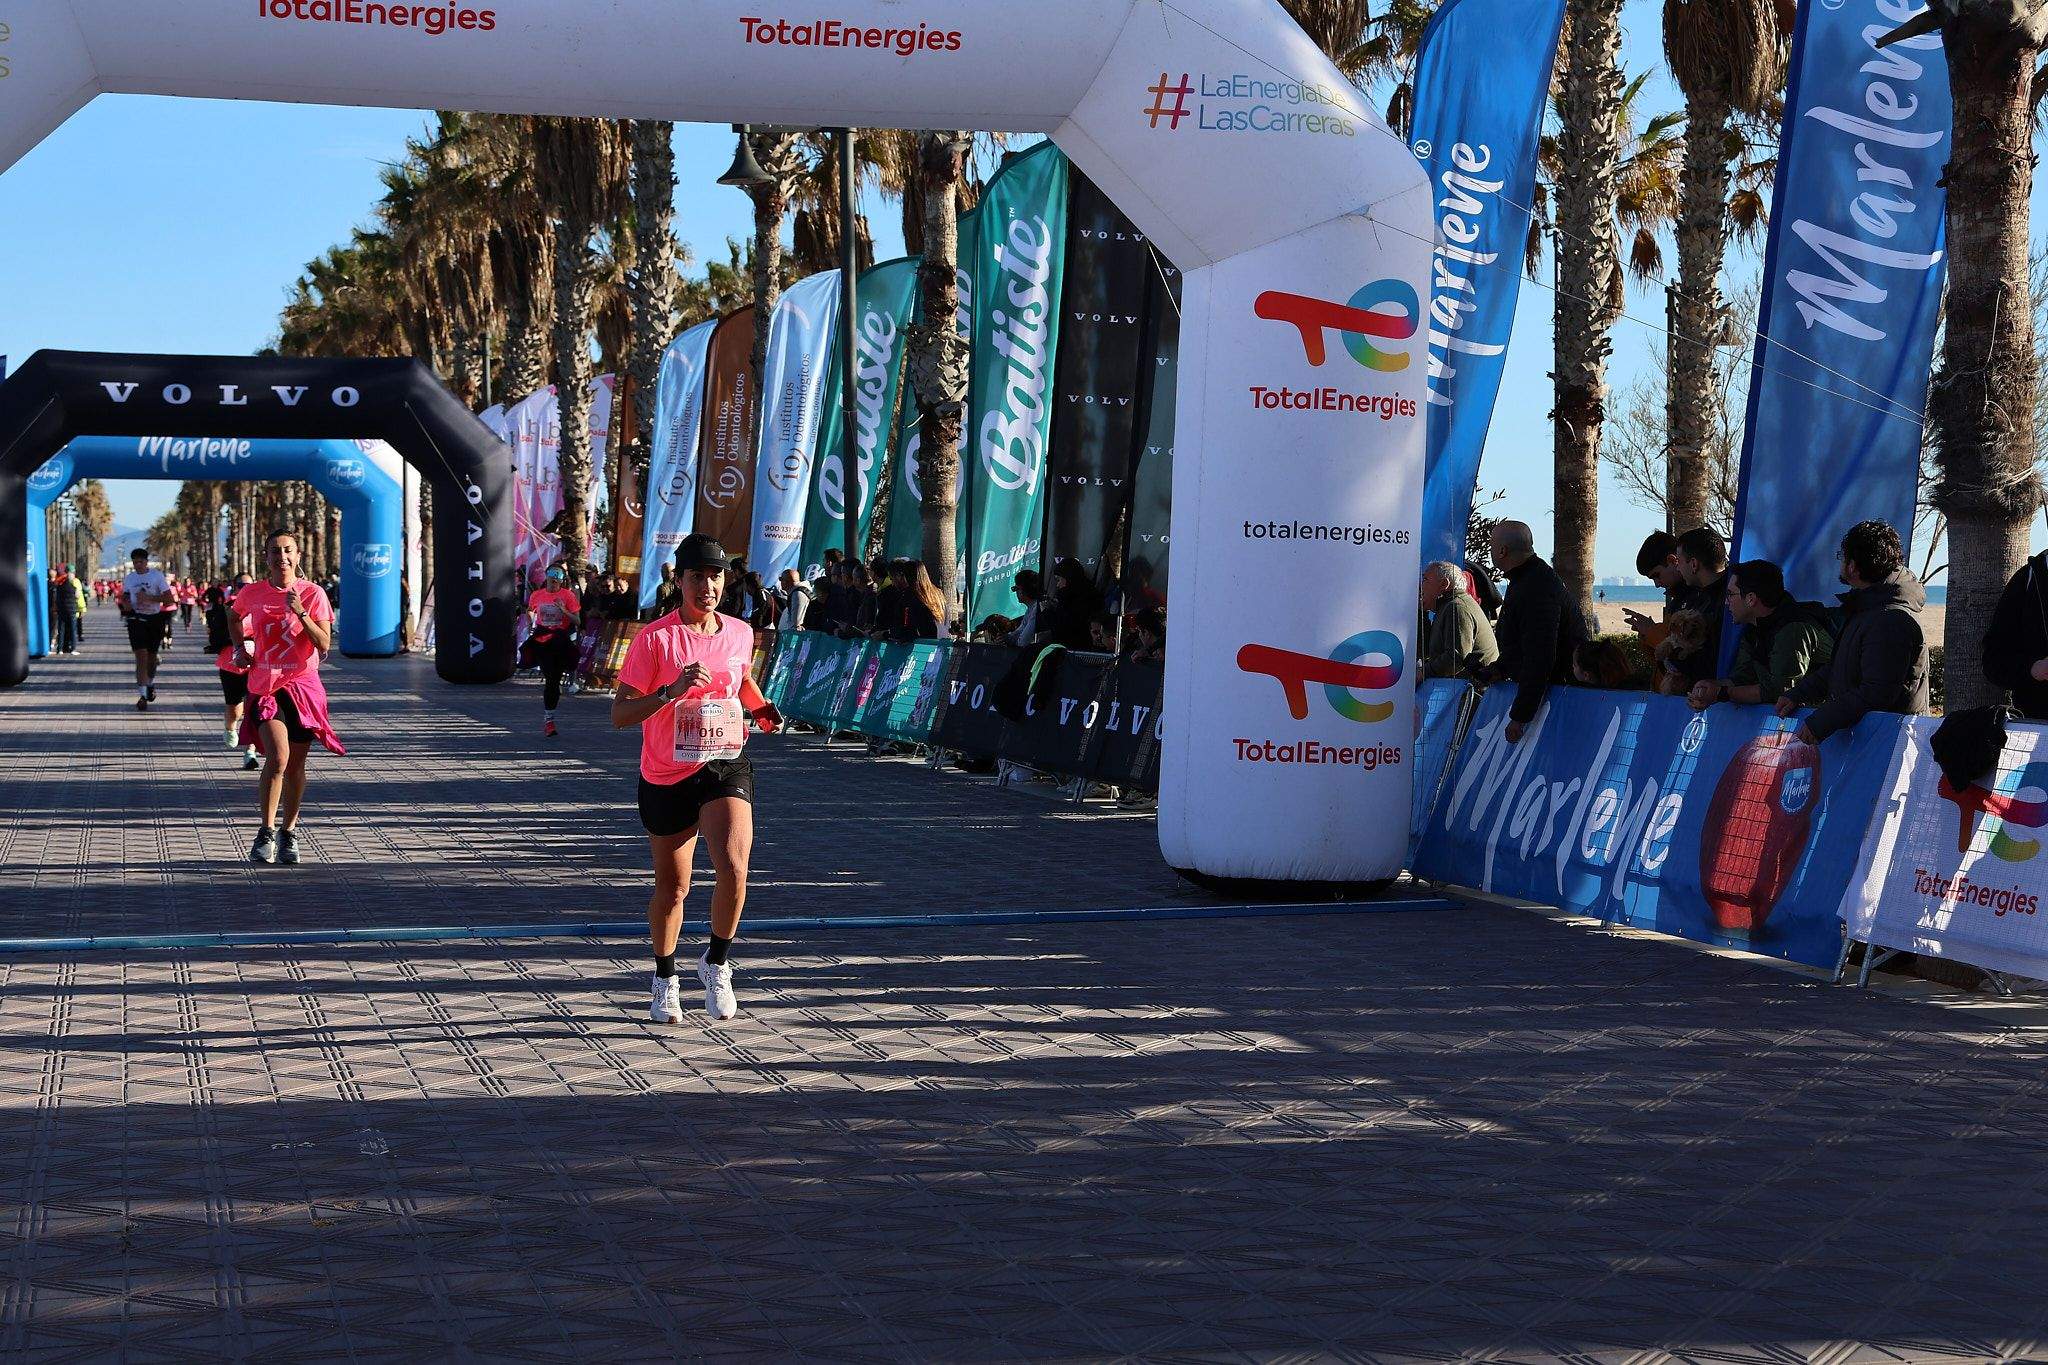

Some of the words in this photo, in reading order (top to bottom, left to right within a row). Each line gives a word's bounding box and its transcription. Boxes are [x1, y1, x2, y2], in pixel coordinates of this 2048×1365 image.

[739, 17, 962, 57] TotalEnergies
[1080, 229, 1145, 242] VOLV
[1074, 312, 1137, 324] VOLV
[980, 214, 1051, 496] Batiste
[100, 381, 360, 407] VOLVO
[1067, 394, 1129, 406] VOLV
[1250, 386, 1416, 420] TotalEnergies
[714, 401, 729, 460] Institutos
[138, 436, 251, 473] Marlene
[1061, 476, 1123, 487] VOLV
[1243, 520, 1410, 545] totalenergies.es
[465, 484, 485, 658] VOLVO
[699, 727, 724, 738] 016
[1232, 738, 1401, 770] TotalEnergies
[1445, 701, 1682, 900] Marlene
[1914, 868, 2039, 917] TotalEnergies
